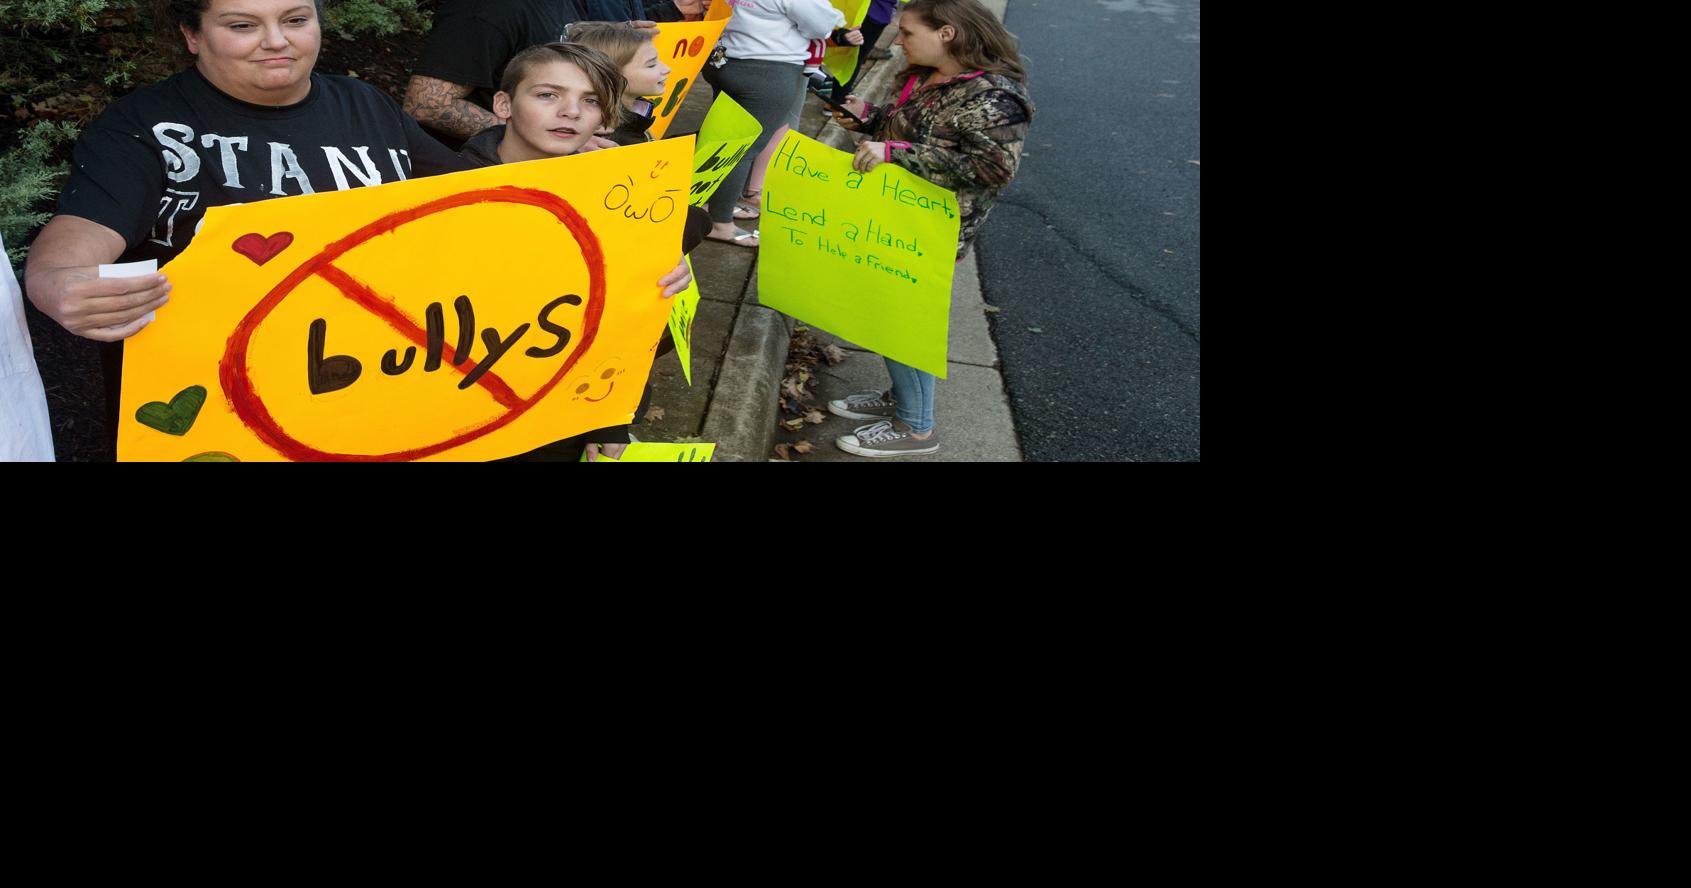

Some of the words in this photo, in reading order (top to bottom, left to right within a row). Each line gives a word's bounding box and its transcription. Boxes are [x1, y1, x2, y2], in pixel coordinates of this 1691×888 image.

[672, 35, 705, 59] no
[774, 135, 830, 182] Have
[846, 171, 864, 189] a
[767, 191, 826, 226] Lend
[841, 222, 859, 242] a
[781, 226, 807, 246] To
[854, 255, 862, 264] a
